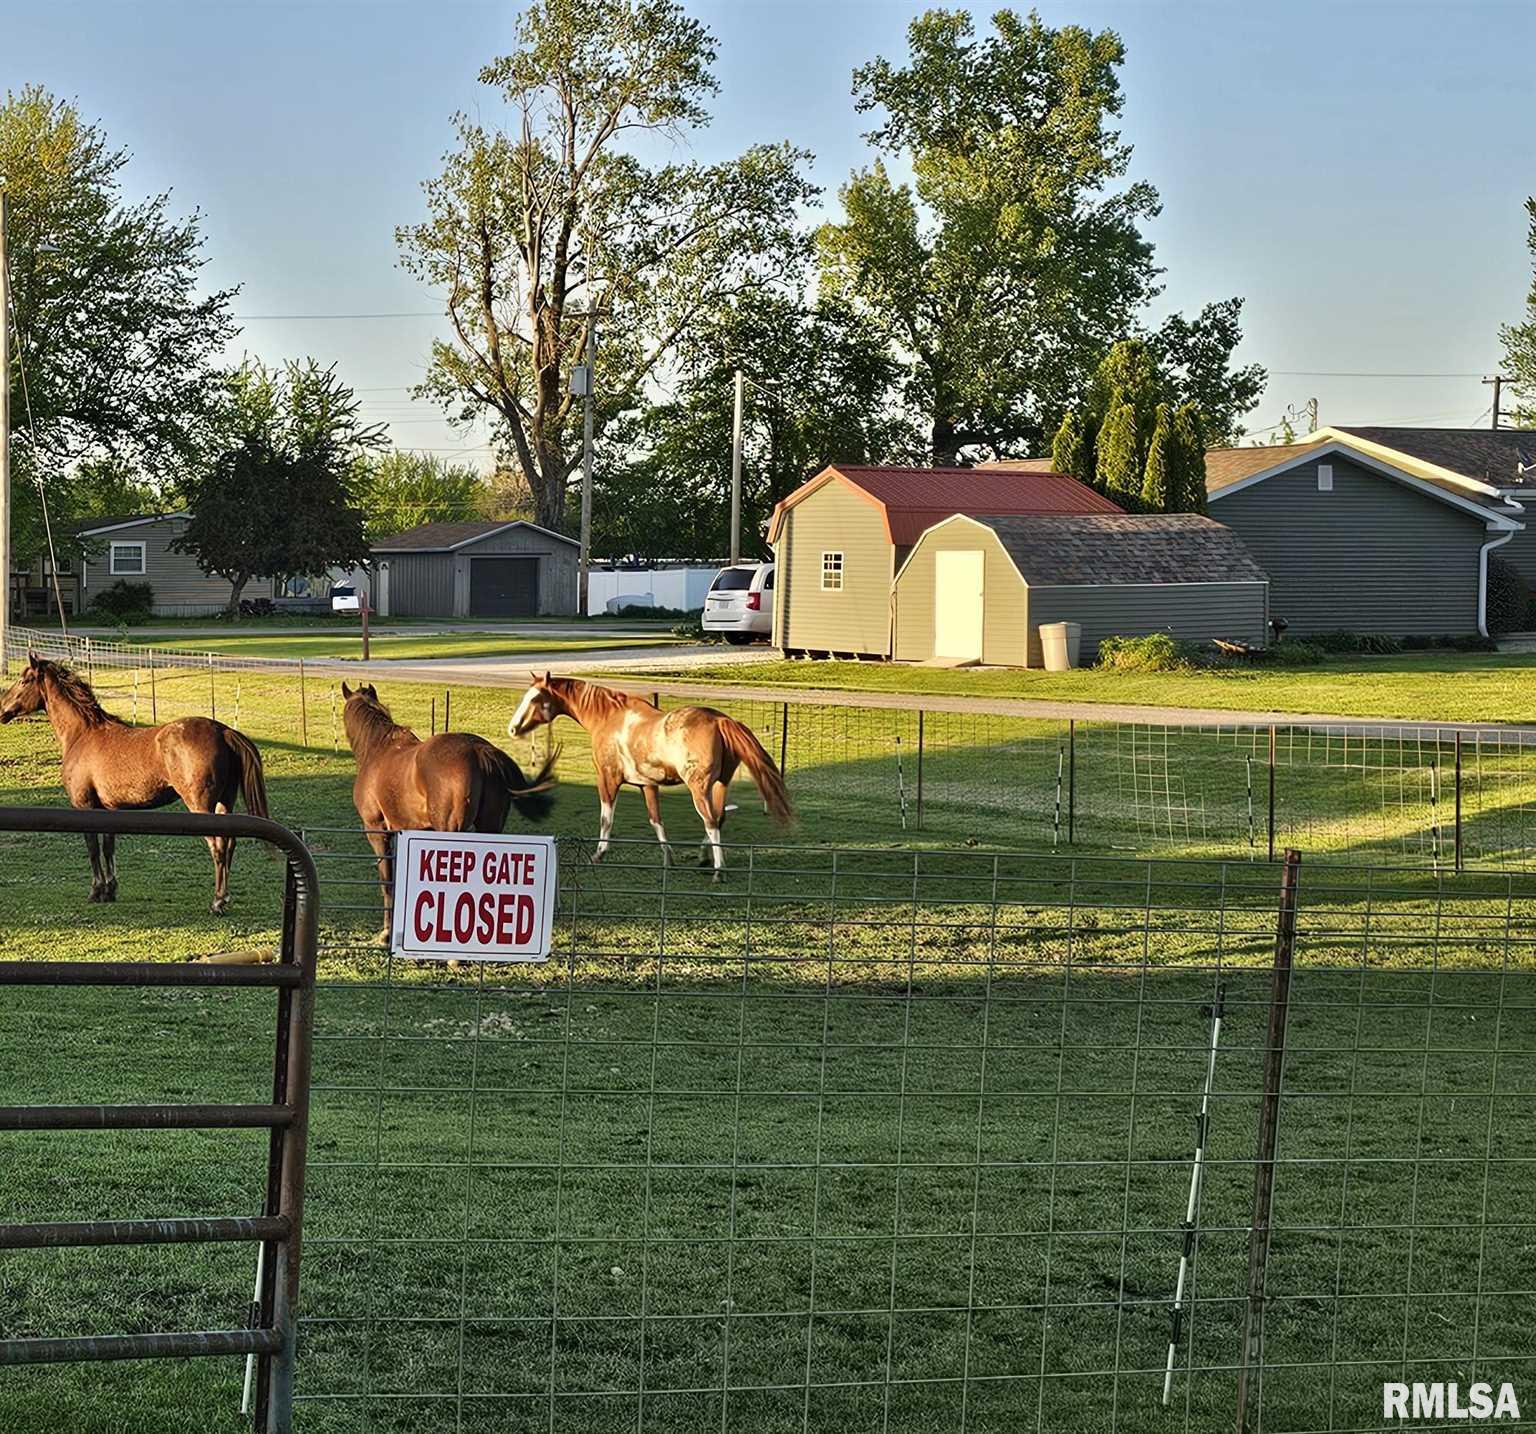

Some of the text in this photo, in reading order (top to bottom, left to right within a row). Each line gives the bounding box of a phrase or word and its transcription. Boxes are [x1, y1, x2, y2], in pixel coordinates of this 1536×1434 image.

[419, 849, 536, 885] KEEP GATE
[414, 890, 535, 945] CLOSED
